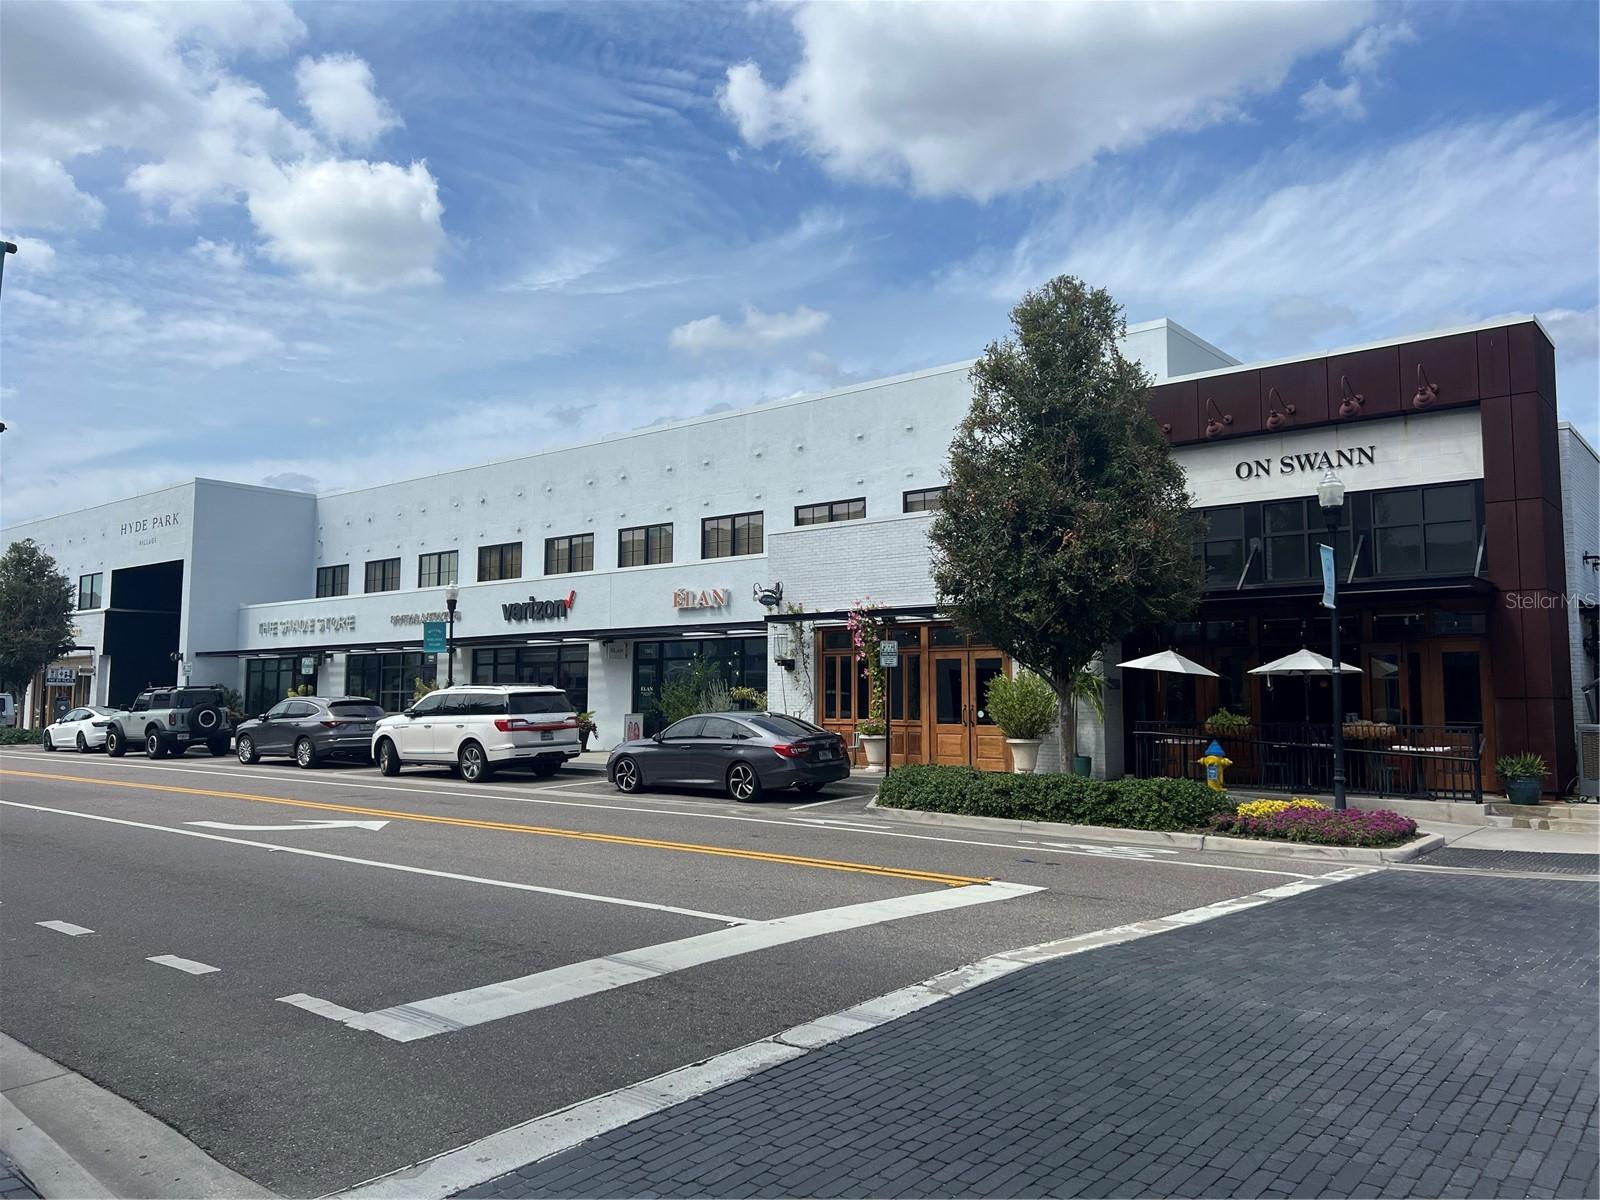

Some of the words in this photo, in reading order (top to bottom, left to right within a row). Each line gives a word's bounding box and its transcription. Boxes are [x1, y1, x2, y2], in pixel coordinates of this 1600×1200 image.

[1235, 458, 1272, 479] ON
[1280, 445, 1376, 474] SWANN
[120, 519, 148, 536] HYDE
[151, 512, 179, 529] PARK
[501, 595, 568, 621] verizon
[316, 614, 356, 632] STORE
